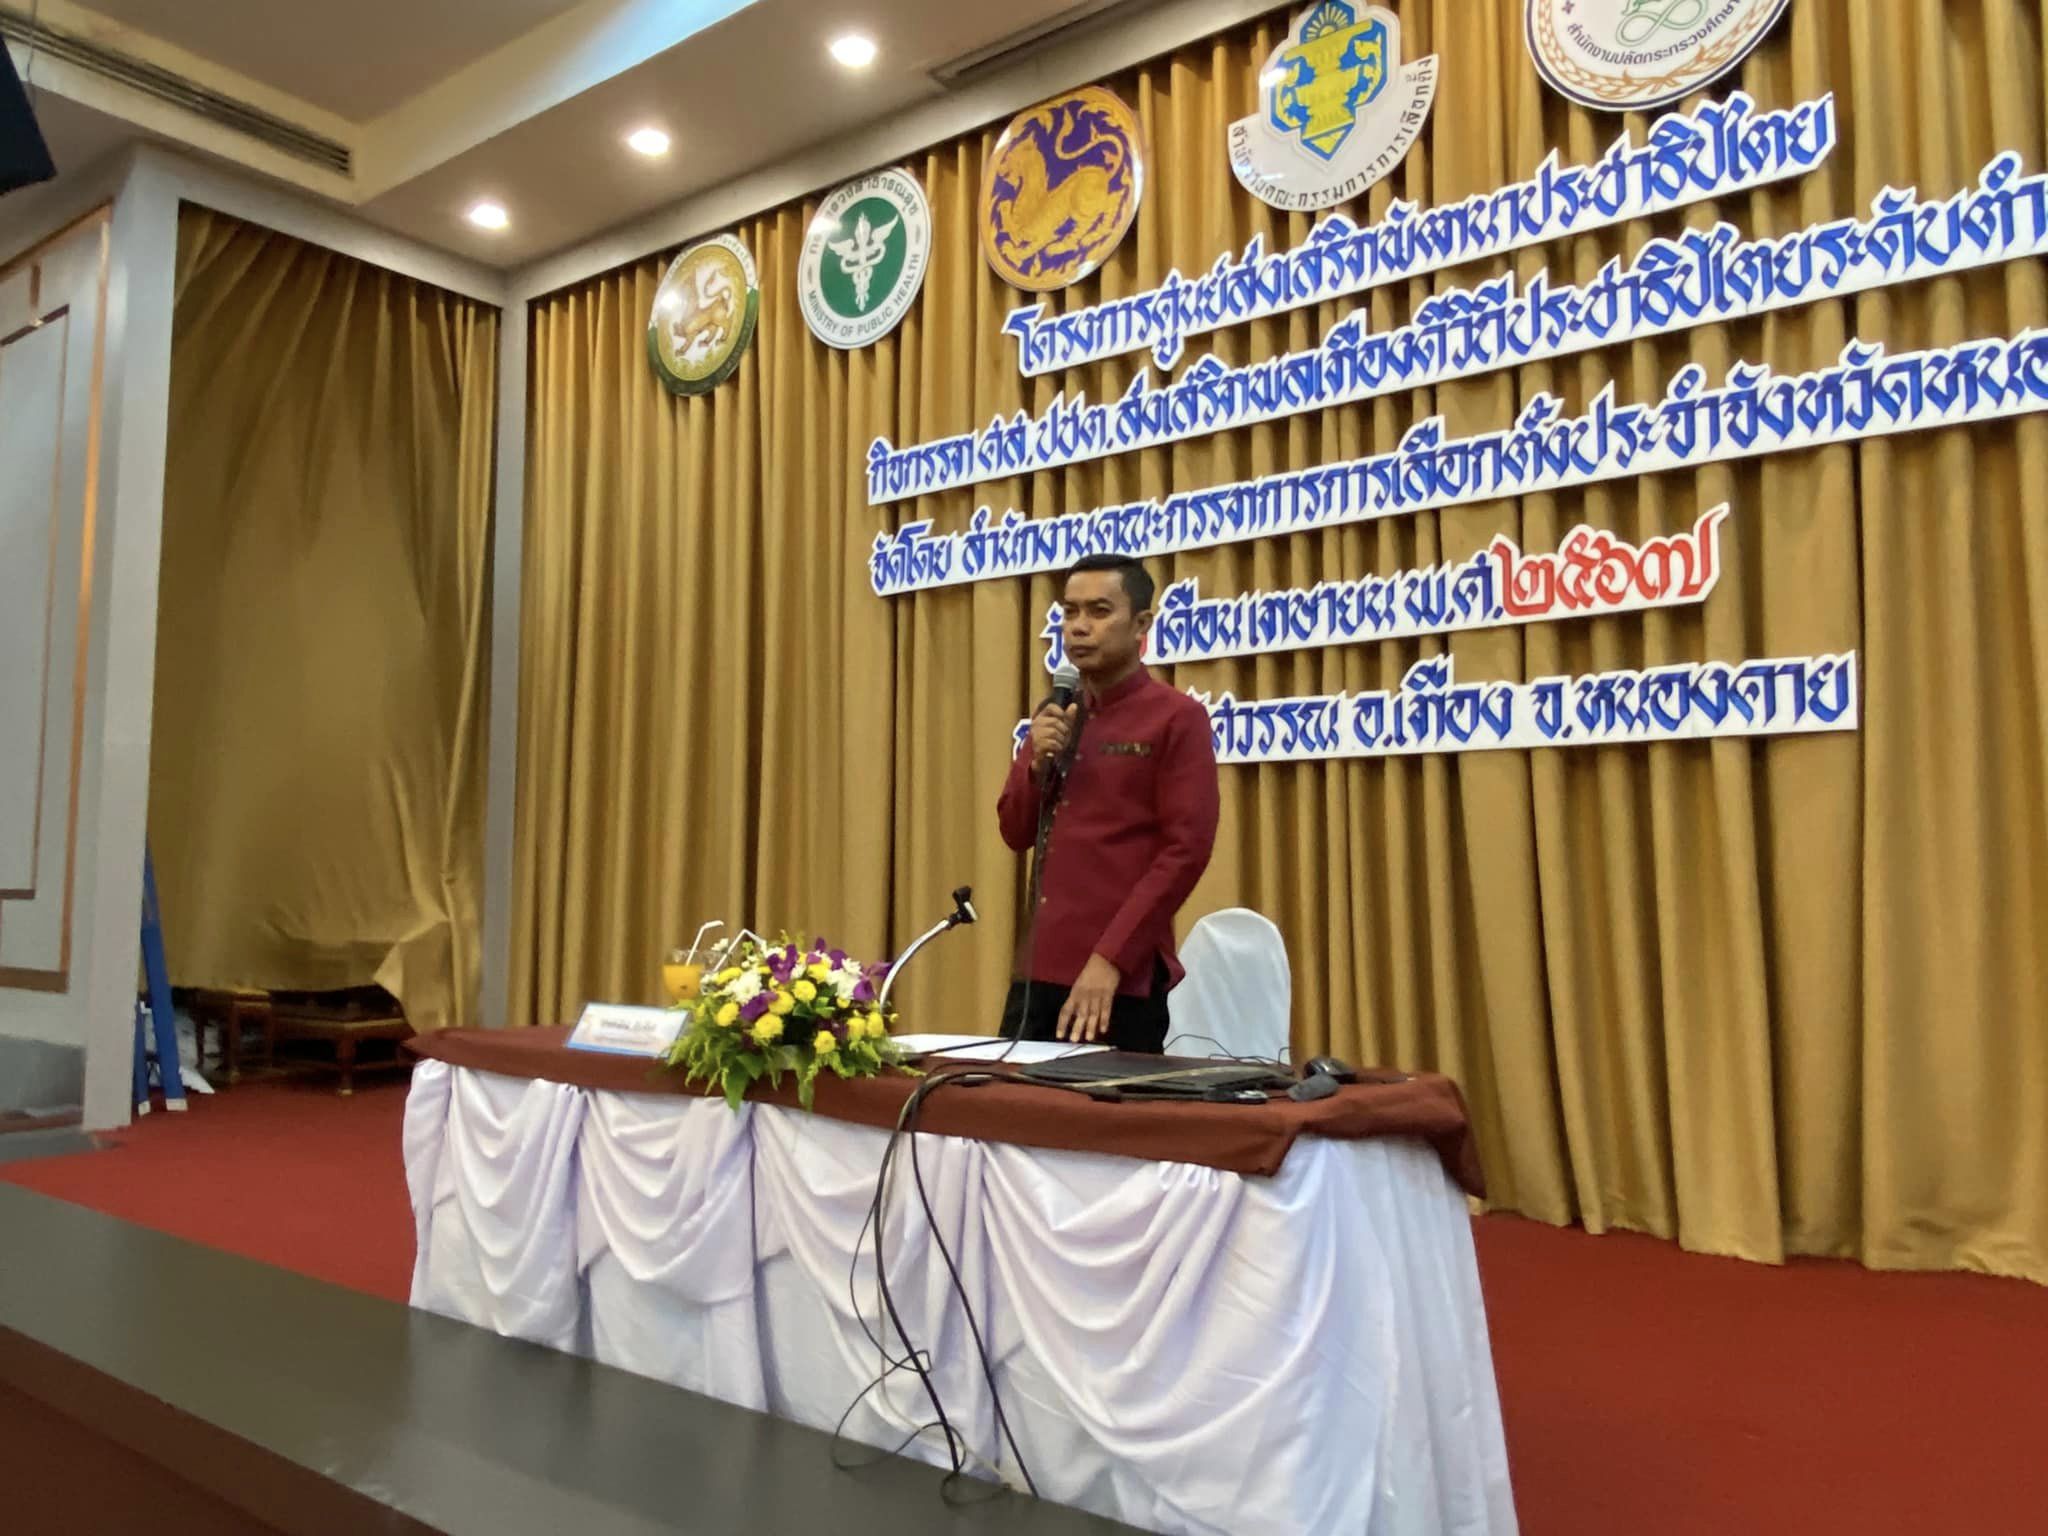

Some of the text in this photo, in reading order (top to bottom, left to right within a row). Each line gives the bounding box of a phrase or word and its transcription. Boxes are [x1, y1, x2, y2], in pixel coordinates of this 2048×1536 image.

[1007, 97, 1829, 371] โครงการศูนย์ส่งเสริมพัฒนาประชาธิปไตย
[808, 253, 920, 338] MINISTRY OF PUBLIC HEALTH
[873, 523, 953, 591] จัดโดย
[1155, 586, 1242, 658] เดือน
[1249, 580, 1396, 646] เมษายน
[1211, 661, 1849, 756] ศวรรณ อ.เมือง จ.หนองคาย
